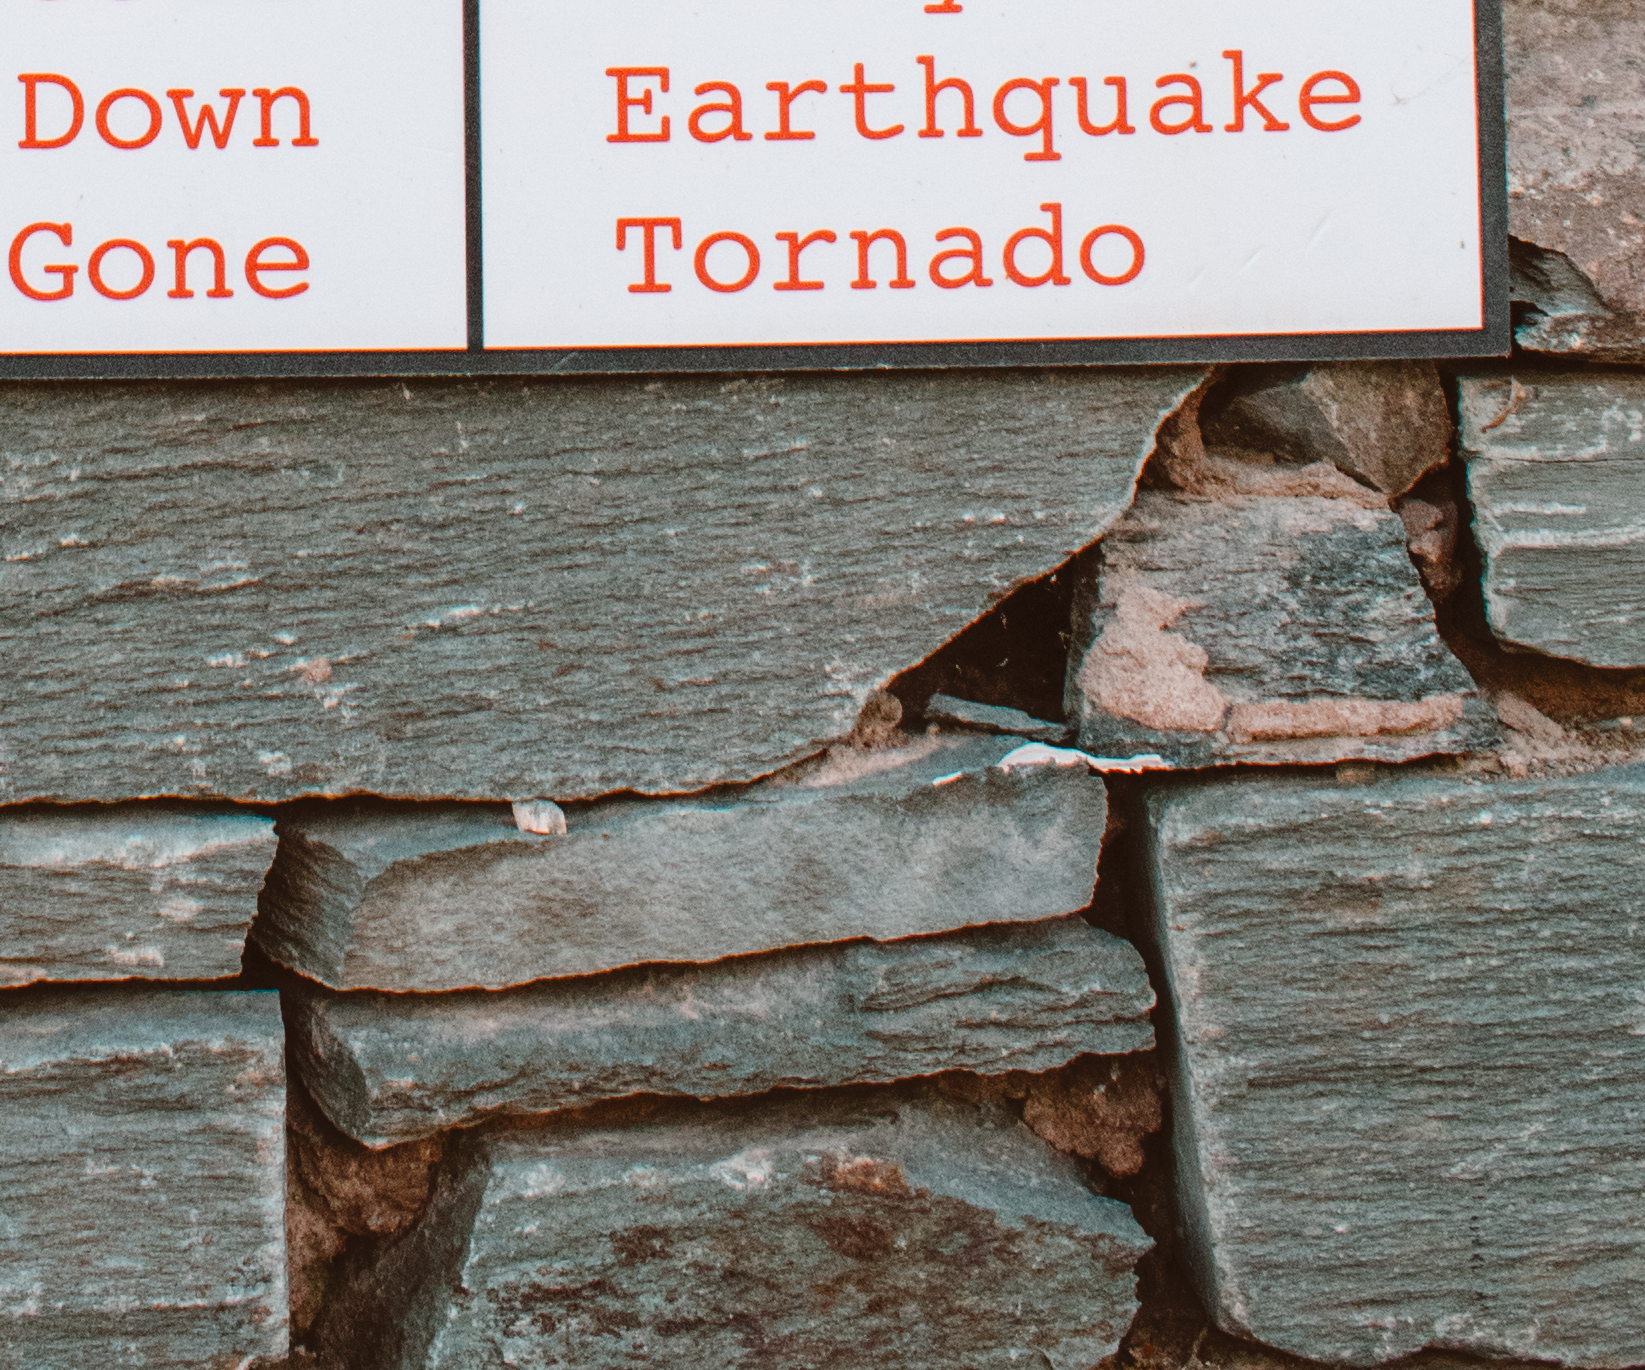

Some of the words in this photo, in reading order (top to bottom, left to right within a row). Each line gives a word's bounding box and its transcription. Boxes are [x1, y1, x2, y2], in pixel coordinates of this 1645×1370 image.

[17, 72, 320, 150] Down
[604, 51, 1362, 162] Earthquake
[8, 220, 310, 302] Gone
[615, 206, 1145, 294] Tornado
